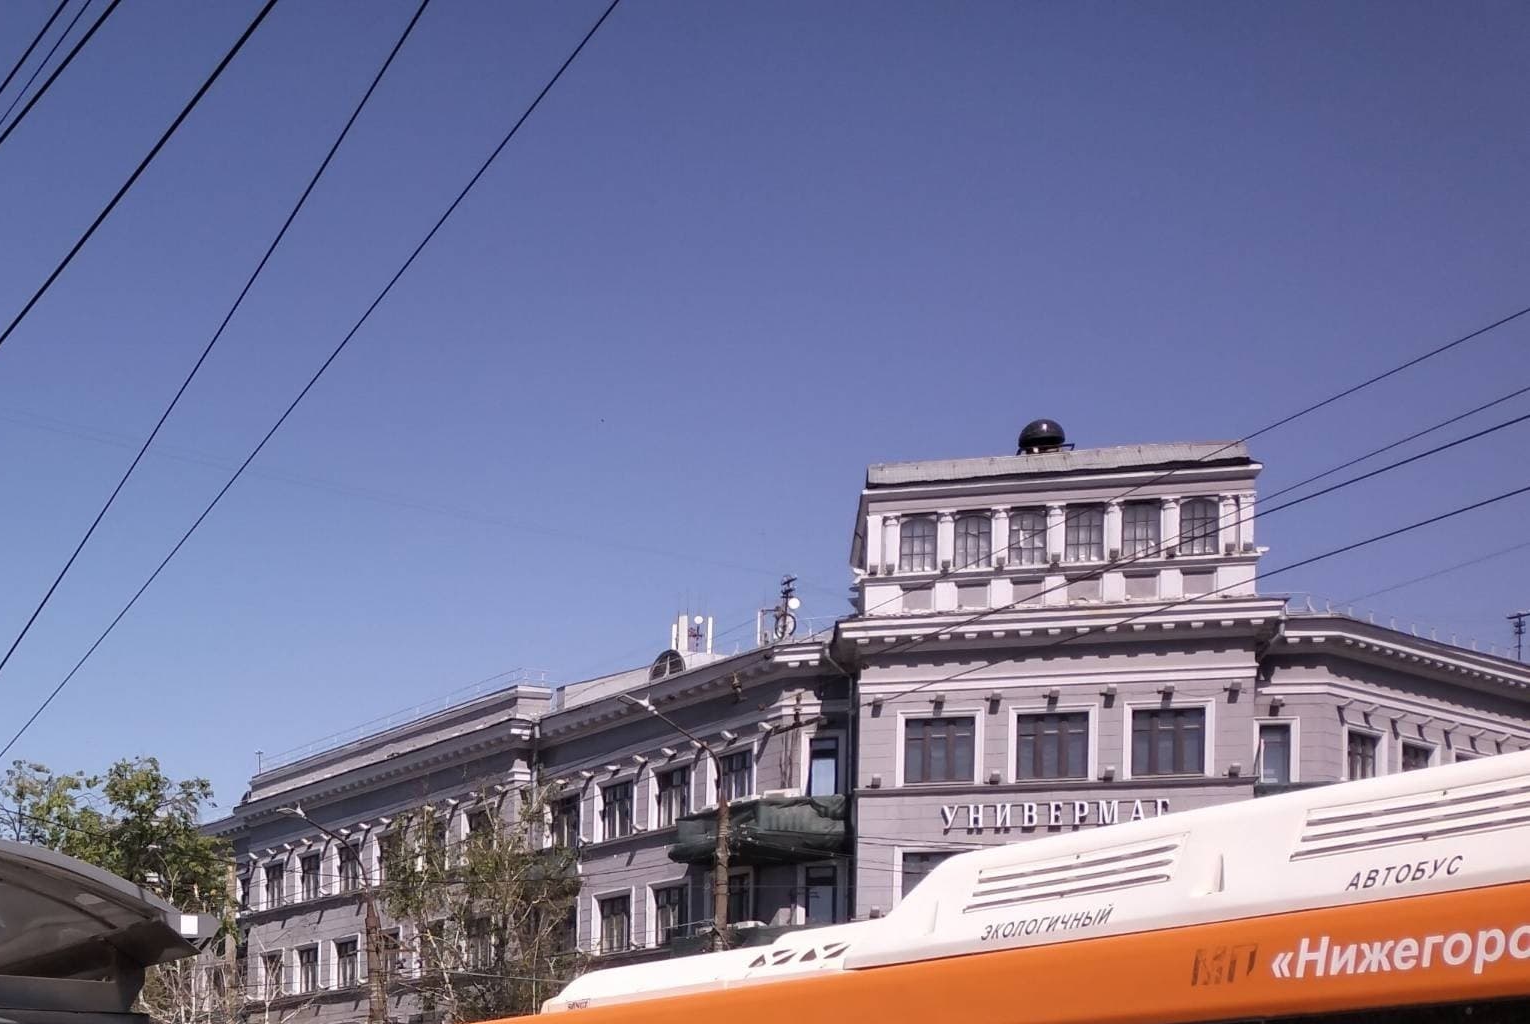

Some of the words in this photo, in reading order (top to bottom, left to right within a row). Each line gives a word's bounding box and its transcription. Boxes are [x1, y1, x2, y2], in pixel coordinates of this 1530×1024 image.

[941, 799, 1170, 829] УНИВЕРМАГ
[980, 903, 1115, 941] ЭКОЛОГИЧНЫЙ
[1345, 855, 1464, 891] АВТОБУС
